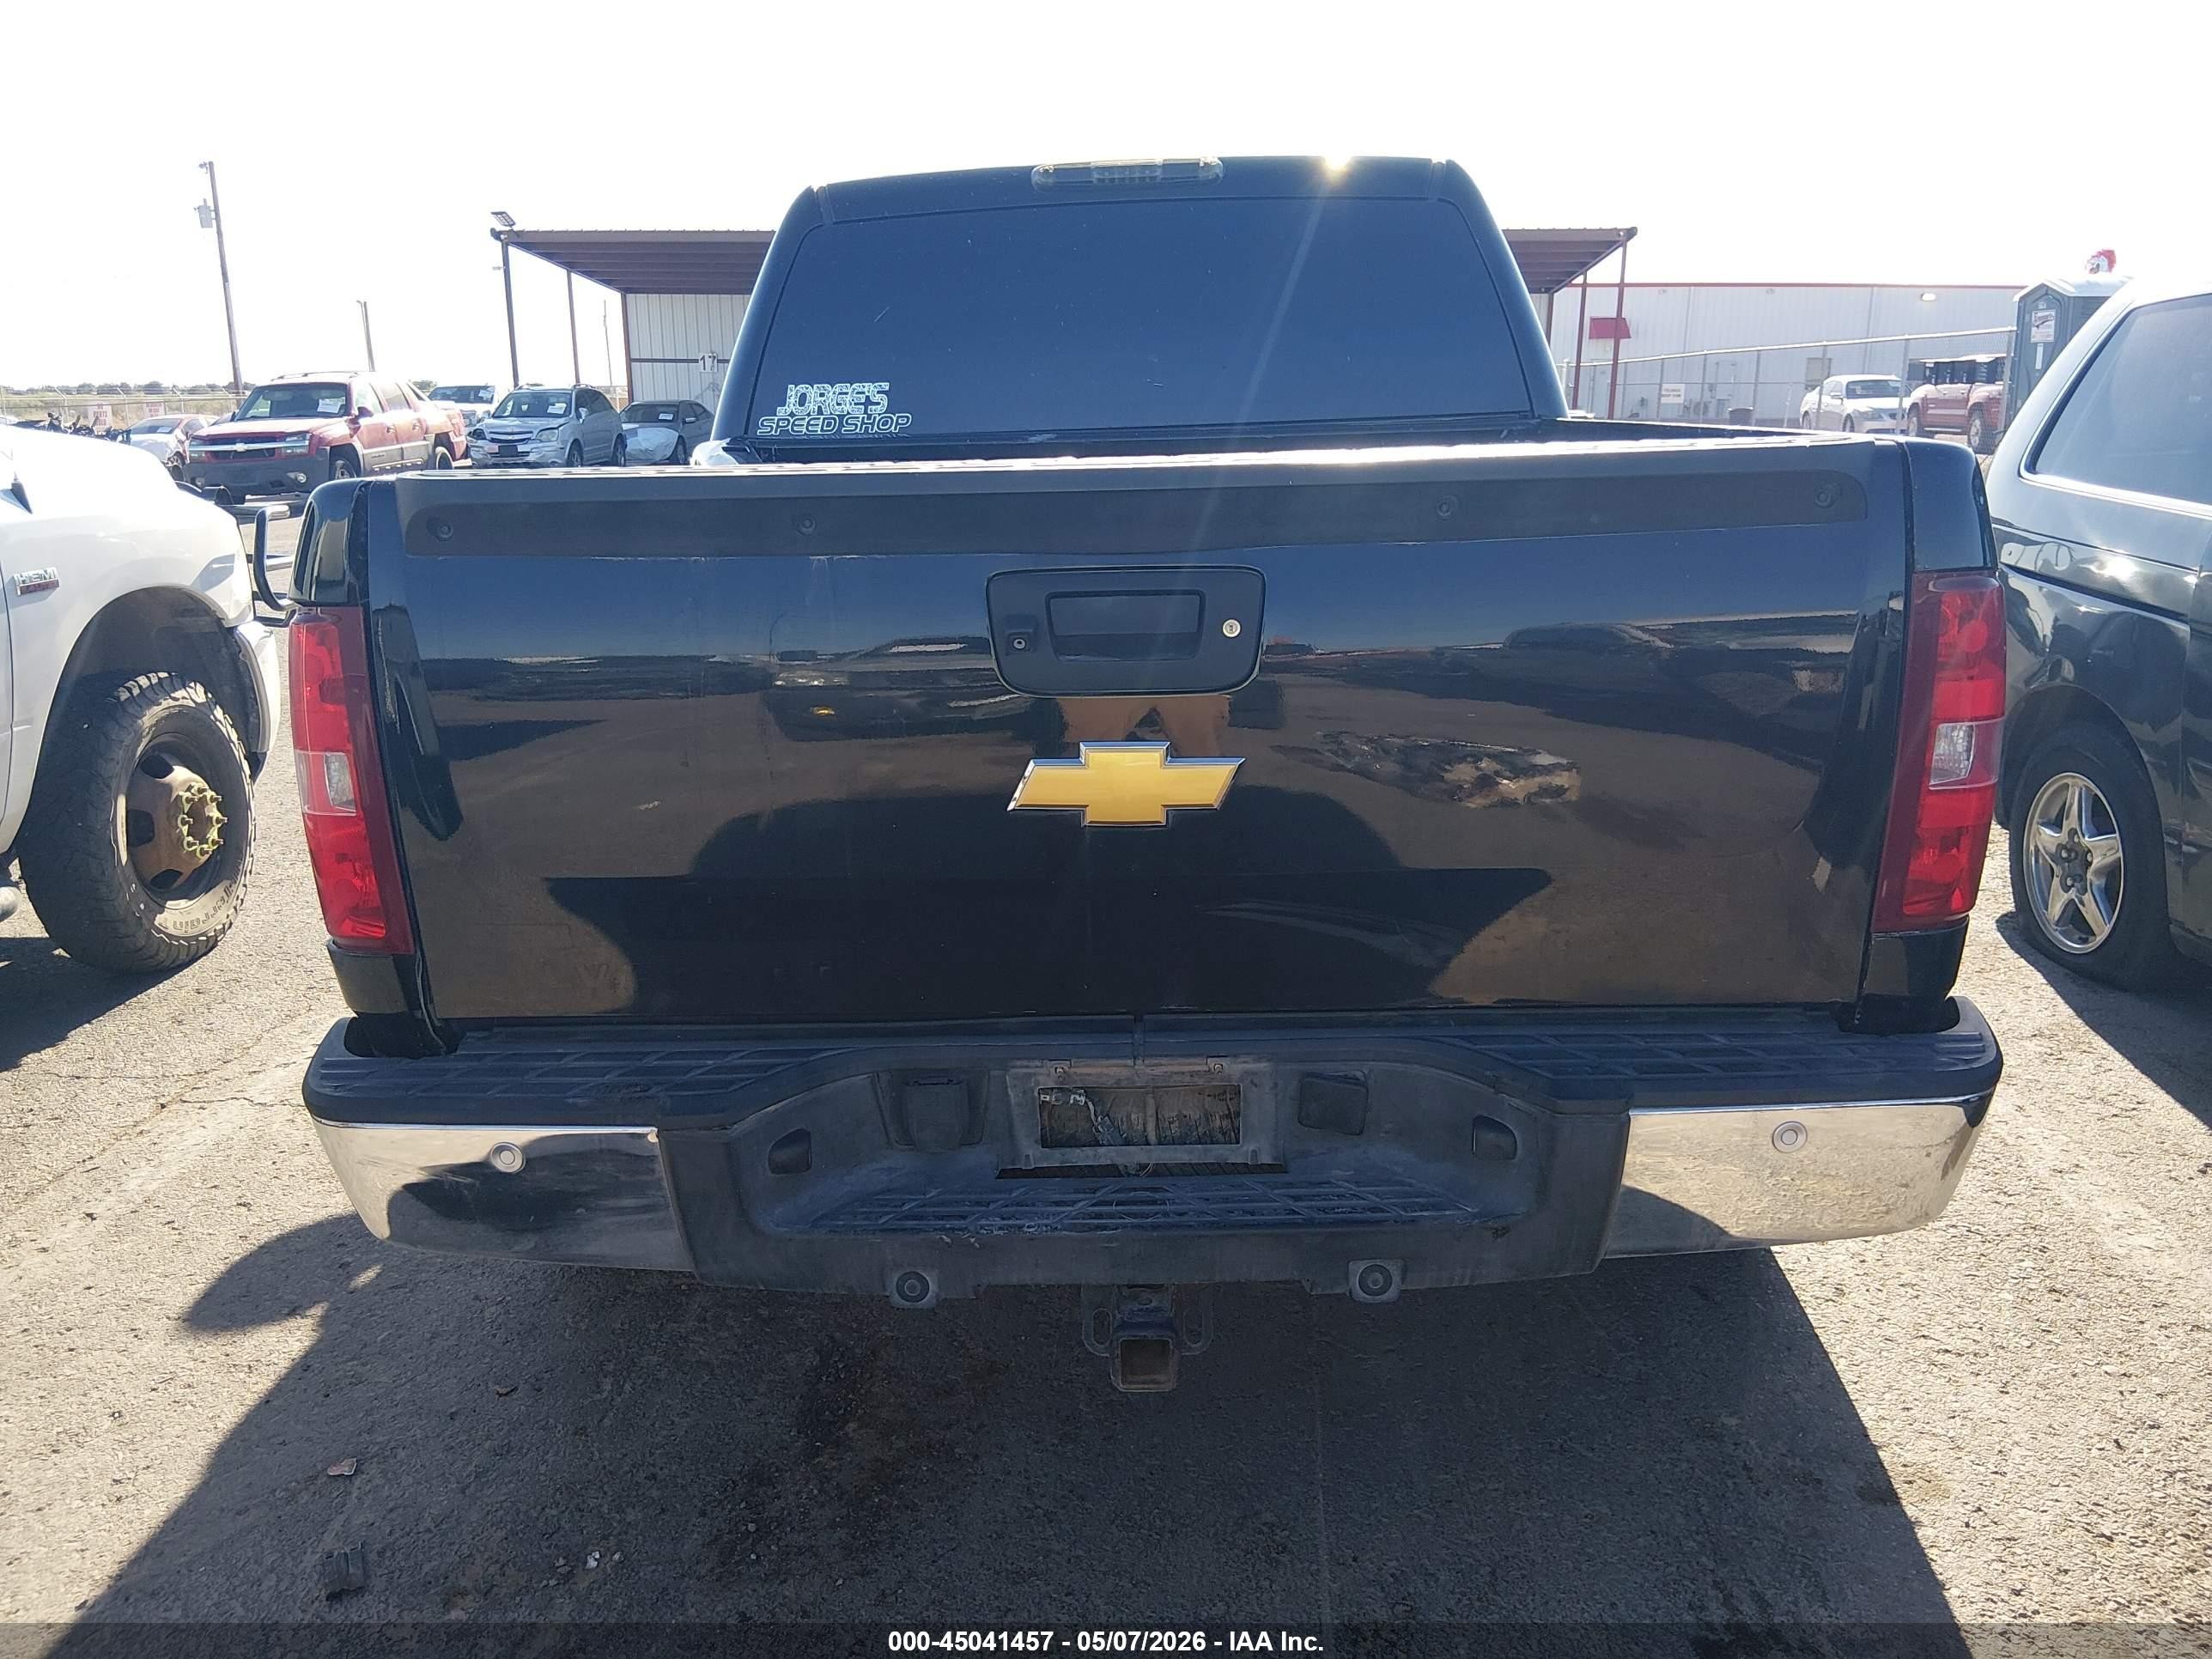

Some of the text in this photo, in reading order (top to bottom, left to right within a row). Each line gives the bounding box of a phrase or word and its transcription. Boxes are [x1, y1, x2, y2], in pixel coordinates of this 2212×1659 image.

[700, 355, 716, 371] 17
[776, 382, 890, 416] JORGE'S
[757, 413, 912, 435] SPEED SHOP
